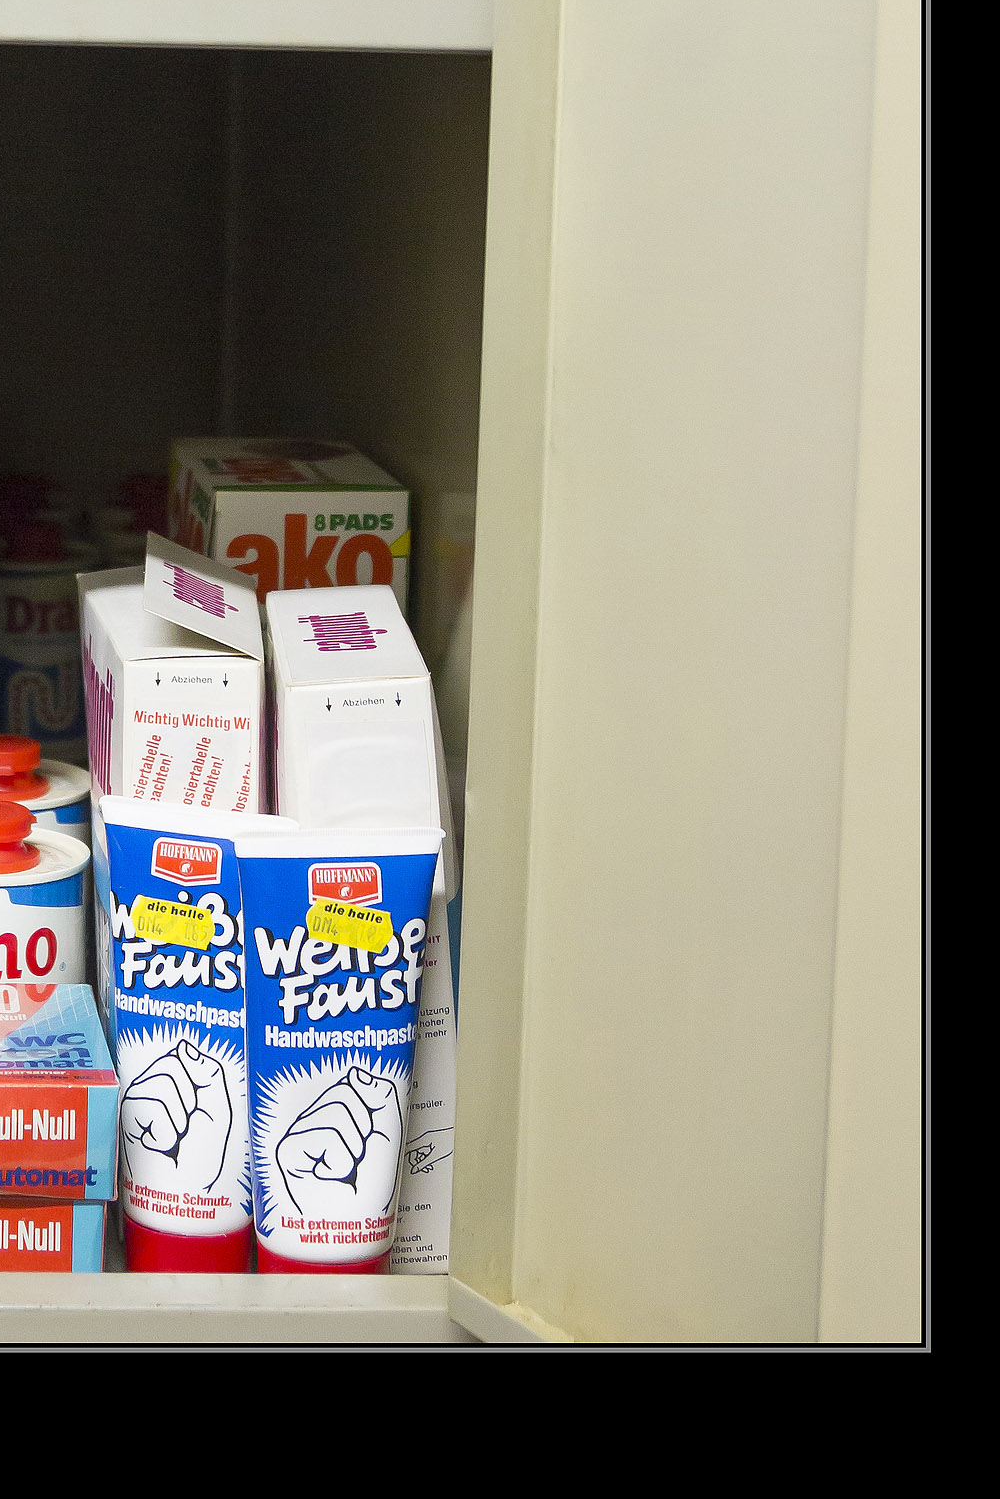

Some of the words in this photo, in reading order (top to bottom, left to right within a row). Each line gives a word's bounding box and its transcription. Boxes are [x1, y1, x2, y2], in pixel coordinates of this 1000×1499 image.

[314, 514, 327, 531] 8
[330, 513, 395, 531] PADS
[226, 513, 394, 604] ako
[171, 674, 213, 685] Abziehen
[342, 696, 385, 707] Abziehen
[182, 713, 230, 731] Wichtig
[147, 902, 167, 913] die
[171, 906, 204, 921] halle
[324, 903, 345, 916] die
[348, 908, 383, 924] halle
[279, 968, 422, 1025] Faust
[9, 1032, 87, 1048] WC
[425, 1029, 448, 1039] mehr
[134, 1184, 180, 1203] extremen
[182, 1193, 233, 1208] Schmutz,
[129, 1194, 149, 1210] wirkt
[152, 1202, 216, 1220] rückfettend
[414, 1203, 432, 1211] den
[281, 1216, 305, 1230] Löst
[308, 1219, 362, 1230] extremen
[299, 1231, 330, 1244] wirkt
[416, 1244, 433, 1252] und
